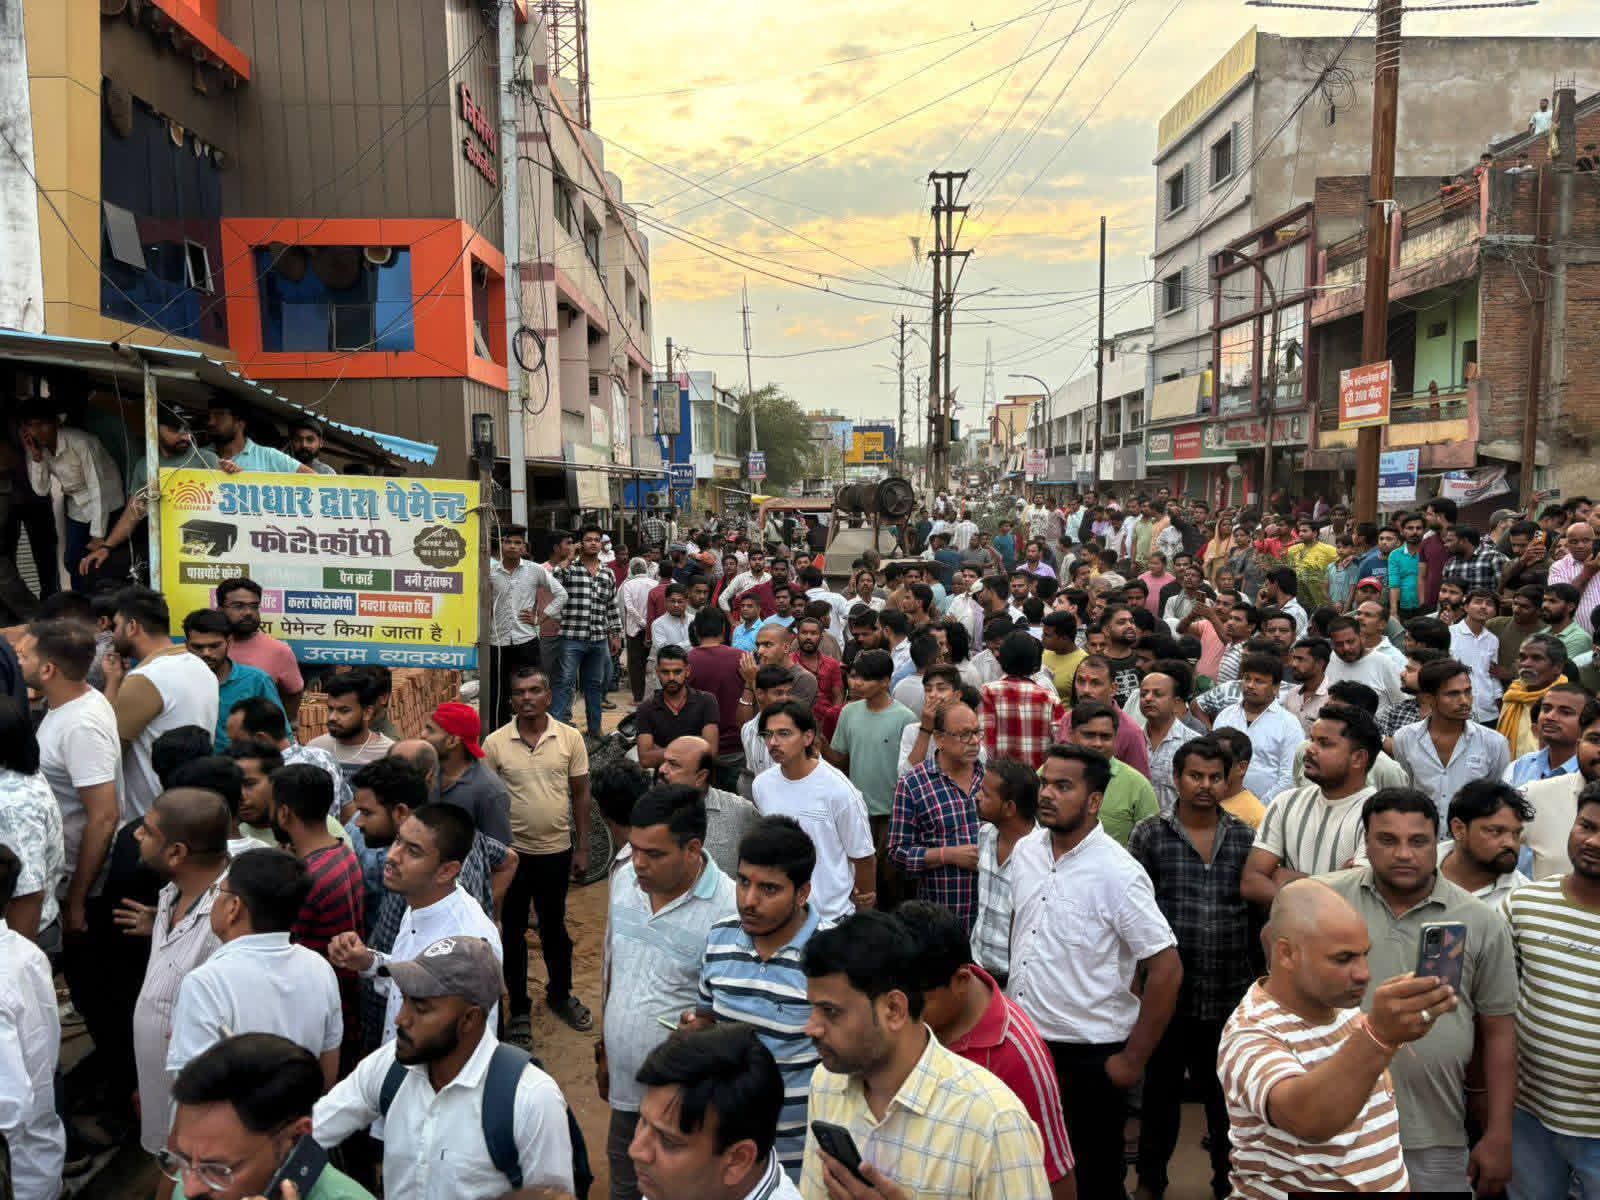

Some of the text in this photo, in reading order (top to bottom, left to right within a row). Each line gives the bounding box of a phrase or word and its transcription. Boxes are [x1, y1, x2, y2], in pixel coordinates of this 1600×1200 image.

[218, 480, 467, 523] आधार द्वारा पेमेन्ट
[249, 525, 393, 557] फोटोकॉपी
[187, 565, 220, 579] पासपोर्ट
[355, 569, 374, 585] कार्ड
[404, 573, 453, 590] मनी ट्रांसफर
[288, 594, 353, 611] कलर फोटोकॉपी
[280, 616, 326, 635] पेमेन्ट
[334, 620, 374, 637] किया
[381, 622, 423, 640] जाता
[430, 621, 442, 642] है
[303, 646, 466, 666] उत्तम व्यवस्था
